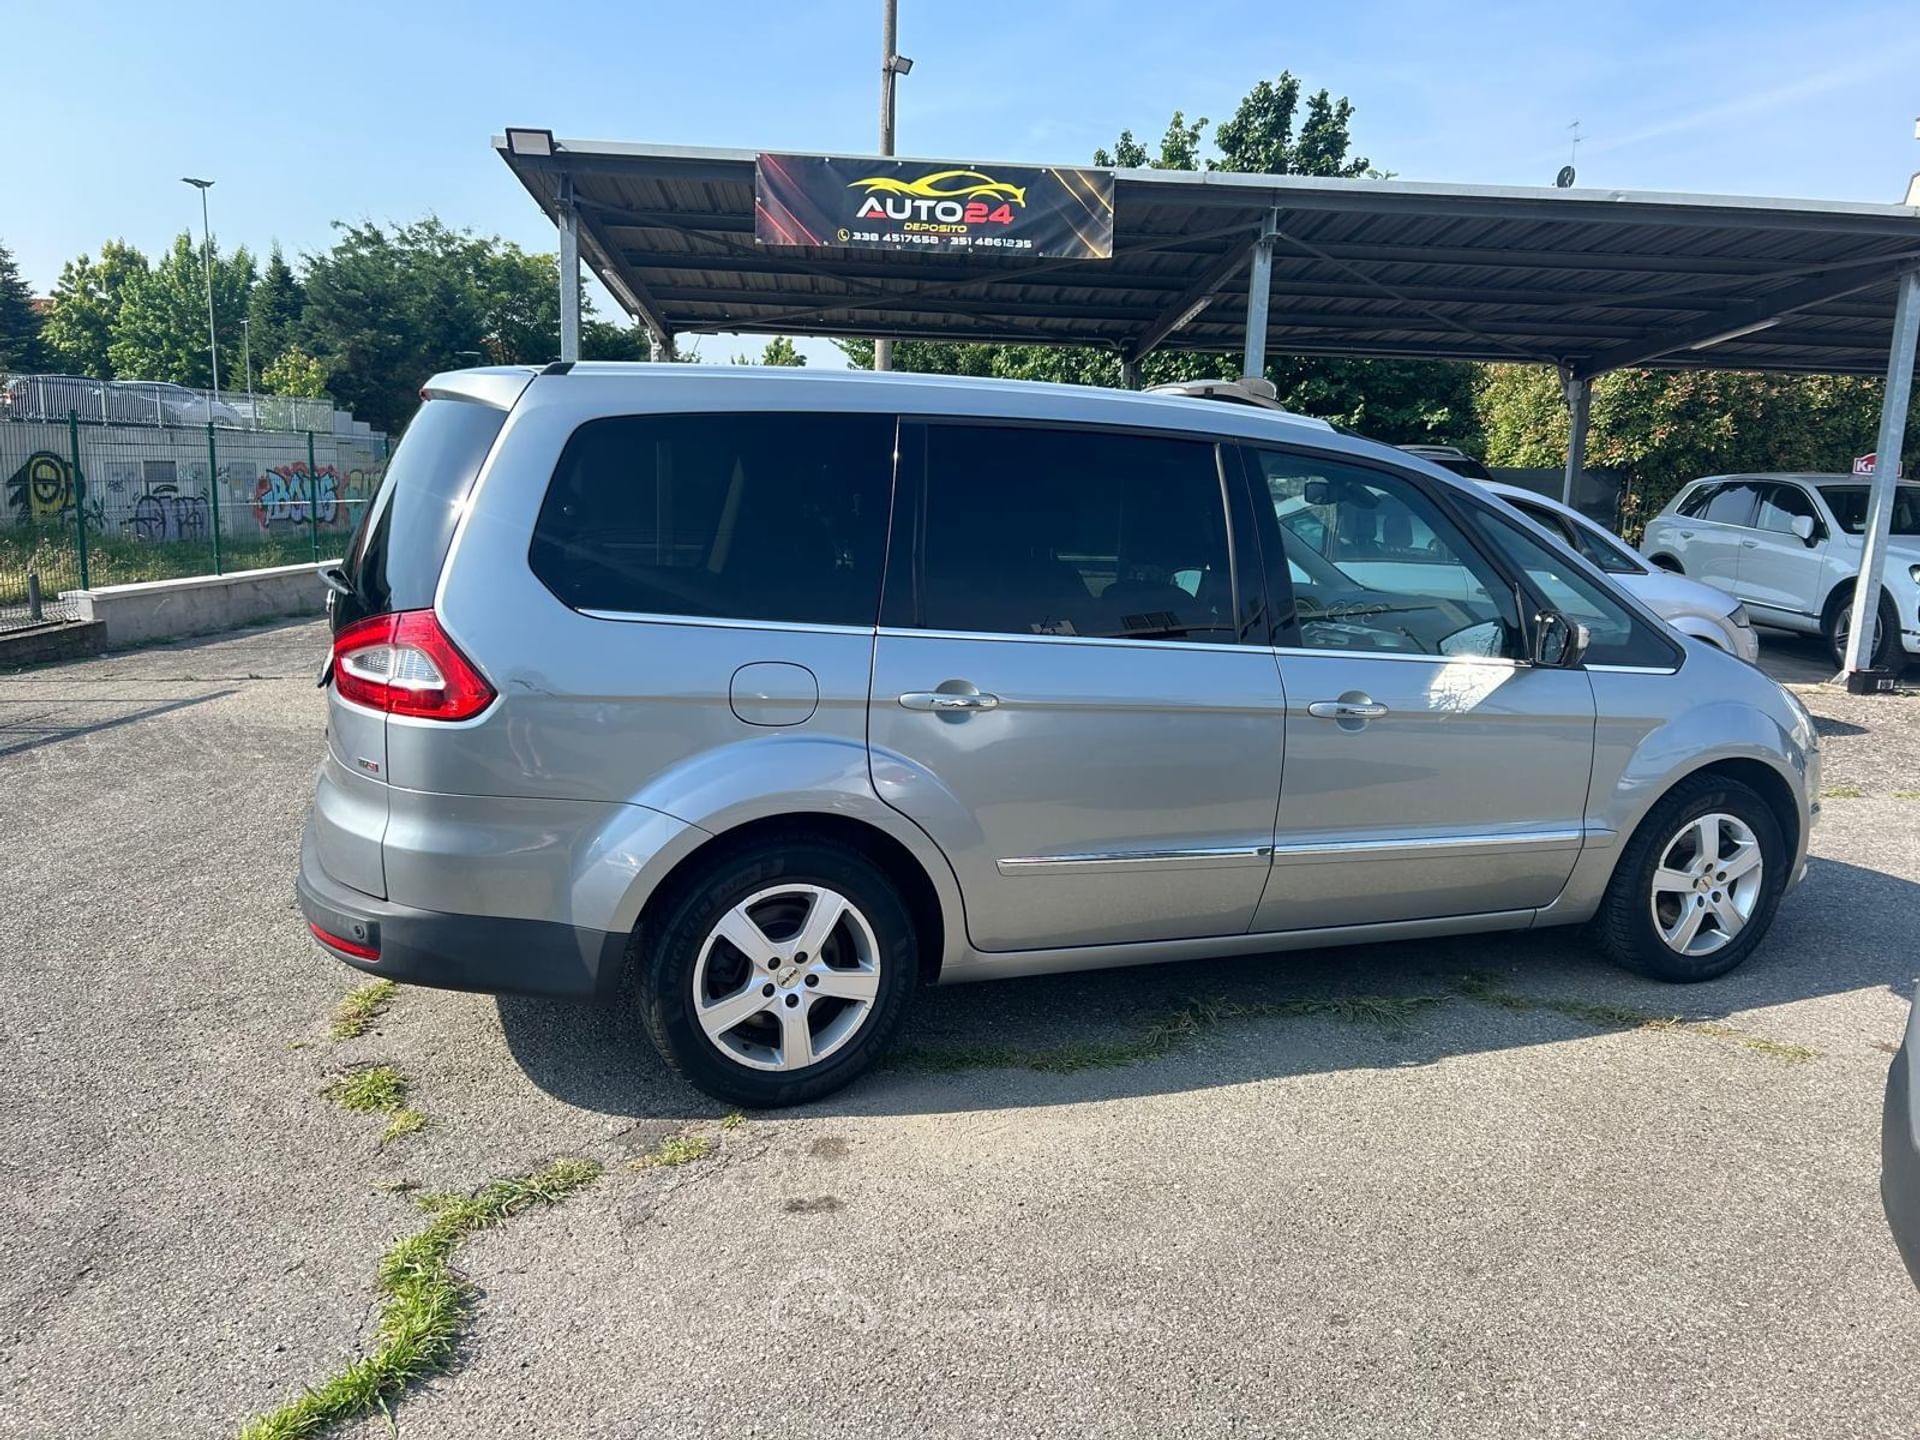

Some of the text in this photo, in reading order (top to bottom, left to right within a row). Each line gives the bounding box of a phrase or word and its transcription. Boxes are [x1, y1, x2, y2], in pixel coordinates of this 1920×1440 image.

[856, 197, 1014, 225] AUTO24
[903, 222, 967, 233] DEPOSITO
[852, 231, 879, 241] 338
[882, 232, 939, 244] 4517658
[950, 236, 972, 246] 351
[975, 237, 1032, 249] 4861235
